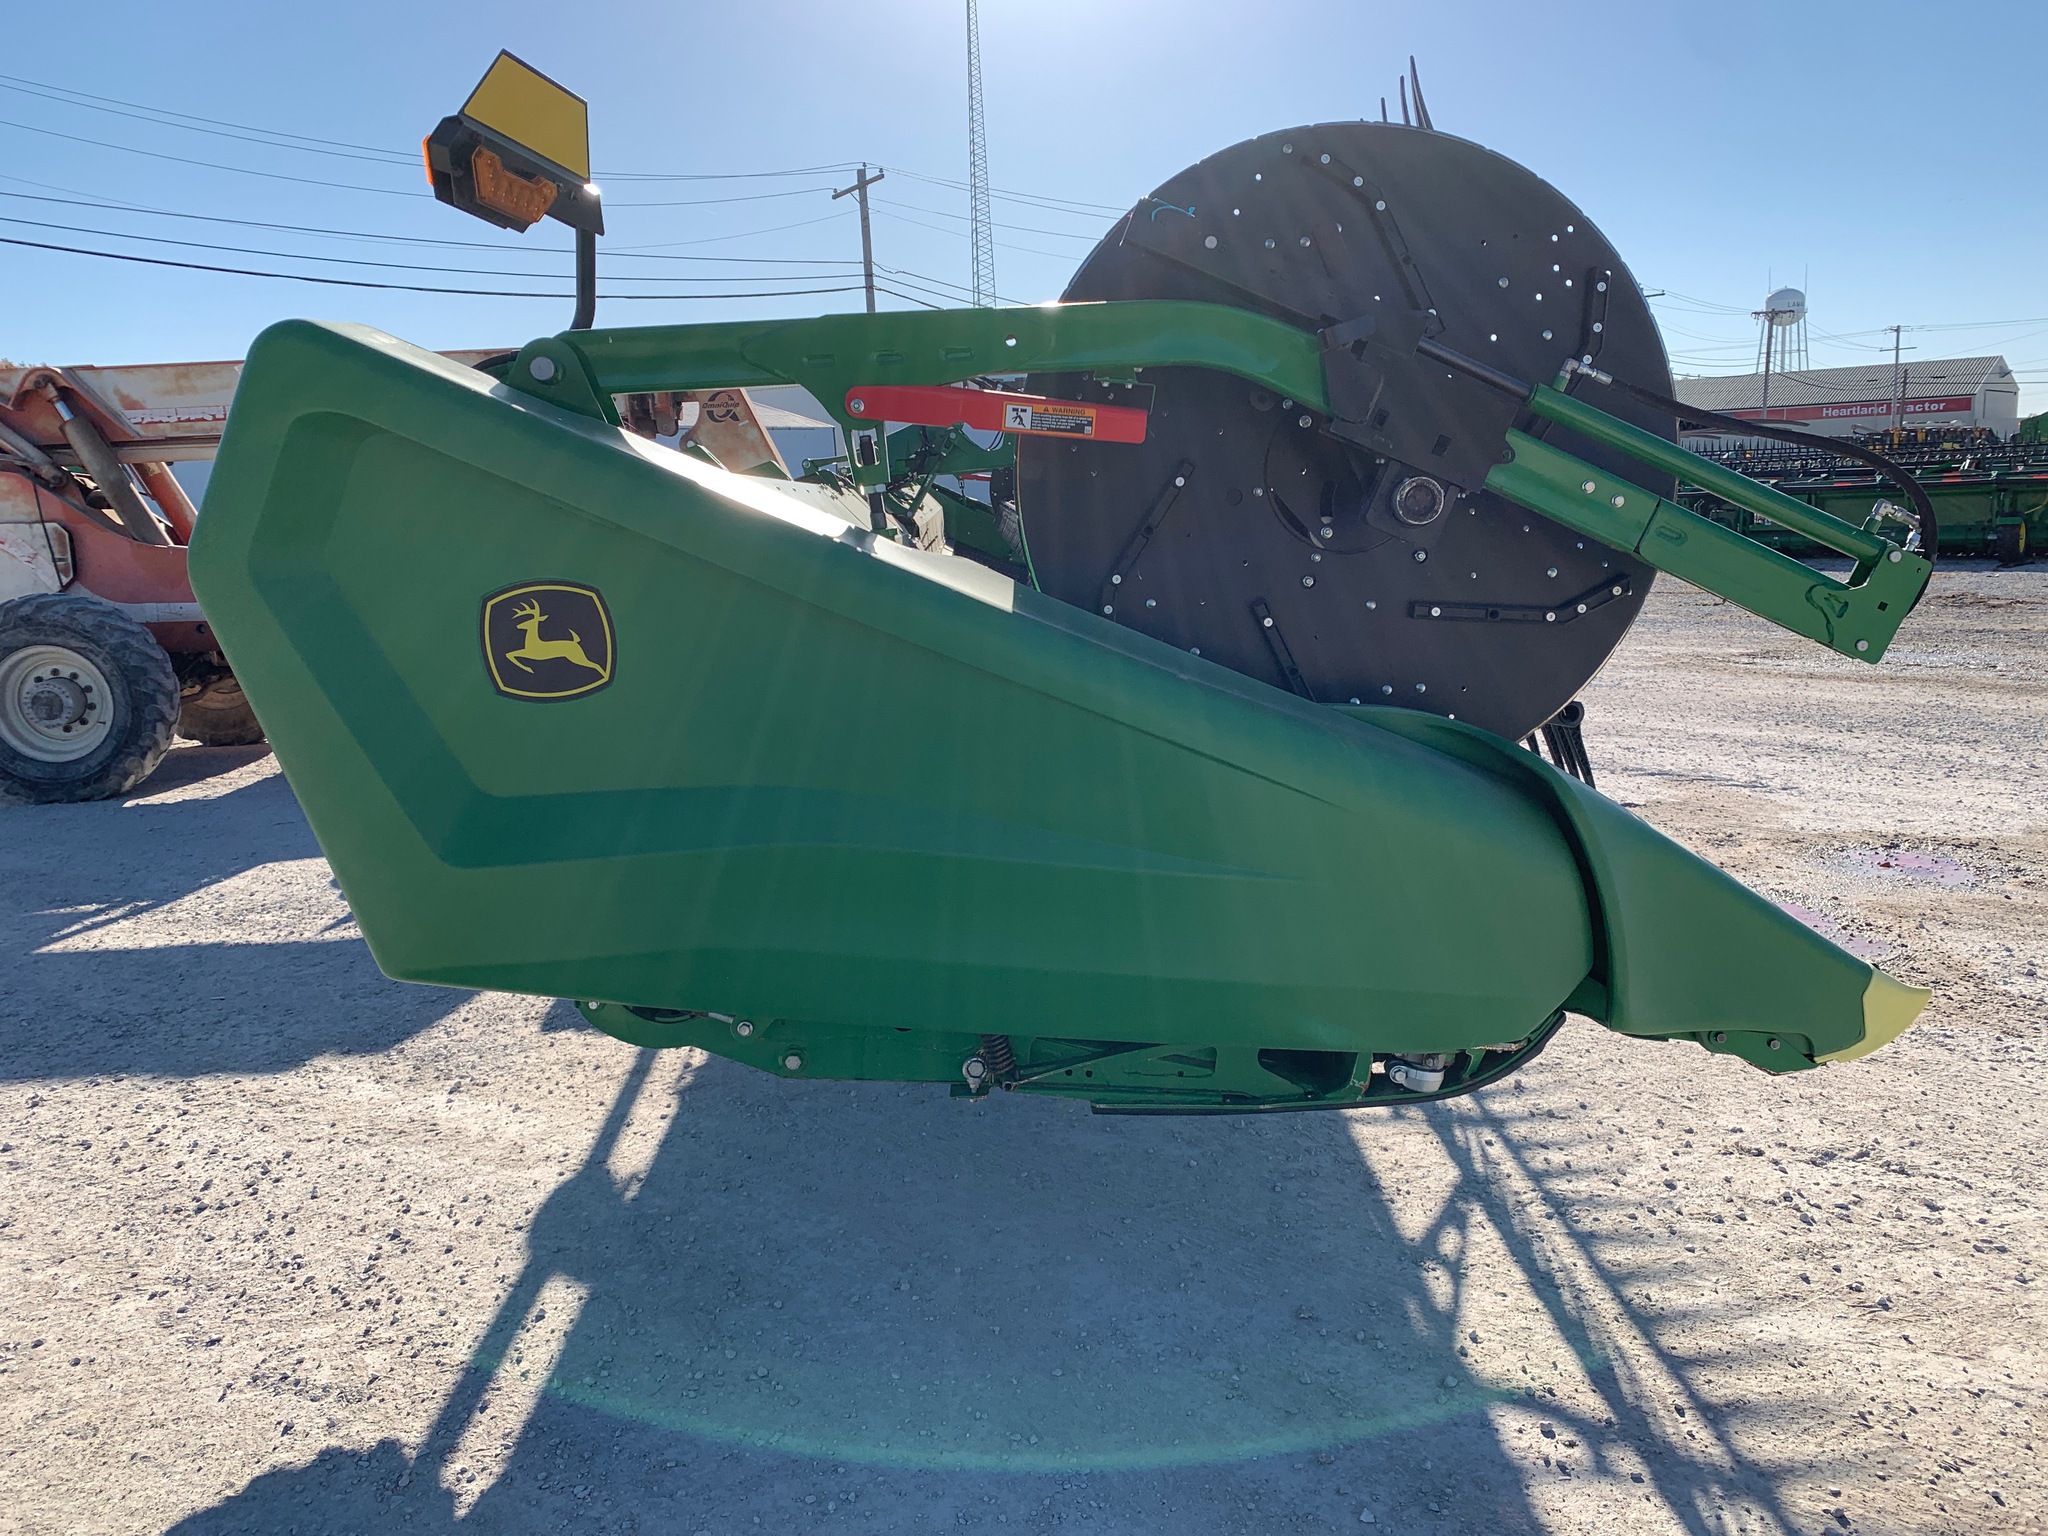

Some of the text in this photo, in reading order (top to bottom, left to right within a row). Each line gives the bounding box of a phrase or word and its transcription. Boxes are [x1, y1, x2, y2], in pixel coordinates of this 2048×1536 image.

[1052, 406, 1086, 415] WARNING
[1822, 401, 1946, 417] Heartland actor
